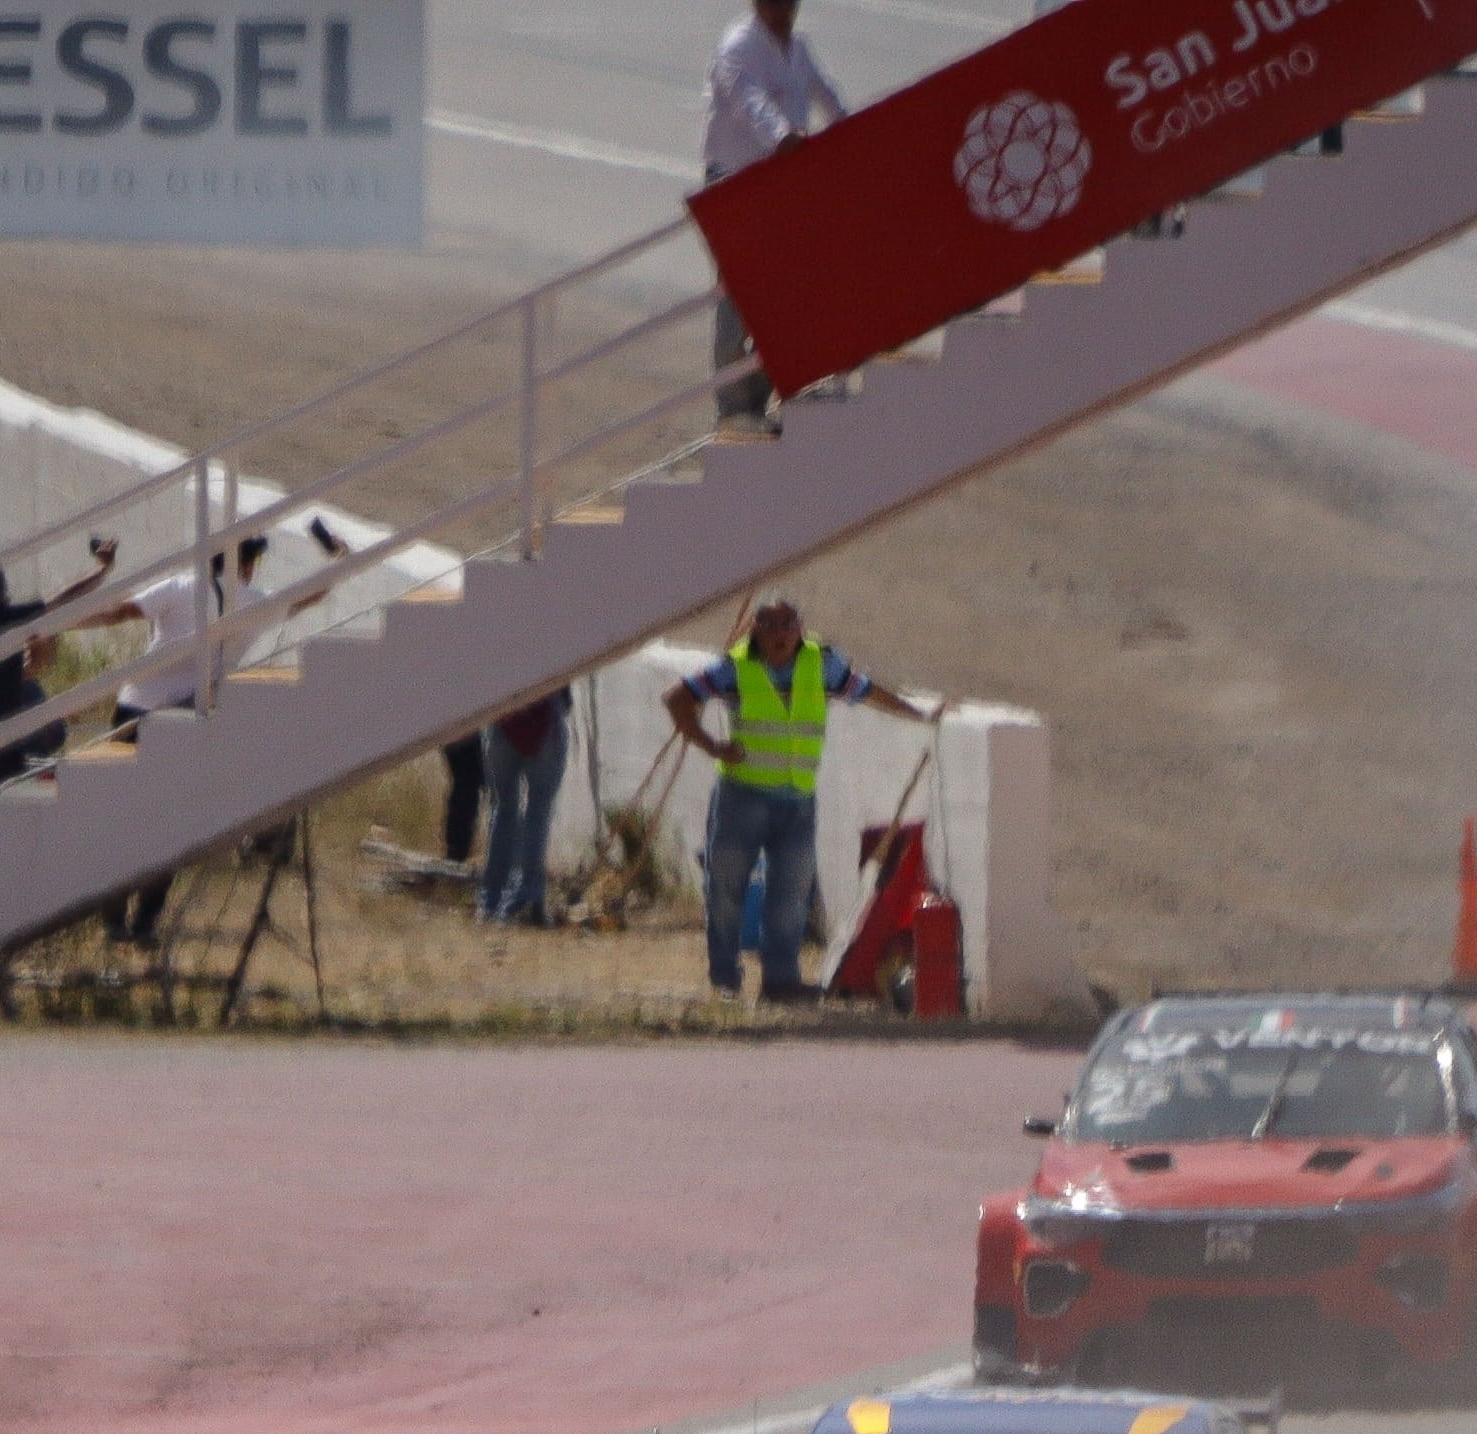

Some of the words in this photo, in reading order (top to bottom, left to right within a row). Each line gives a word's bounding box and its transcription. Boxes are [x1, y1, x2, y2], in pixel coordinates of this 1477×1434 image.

[1103, 30, 1216, 109] San
[1232, 0, 1331, 52] Ju
[1131, 46, 1317, 152] Gobierno
[166, 162, 389, 202] ORIGINAL
